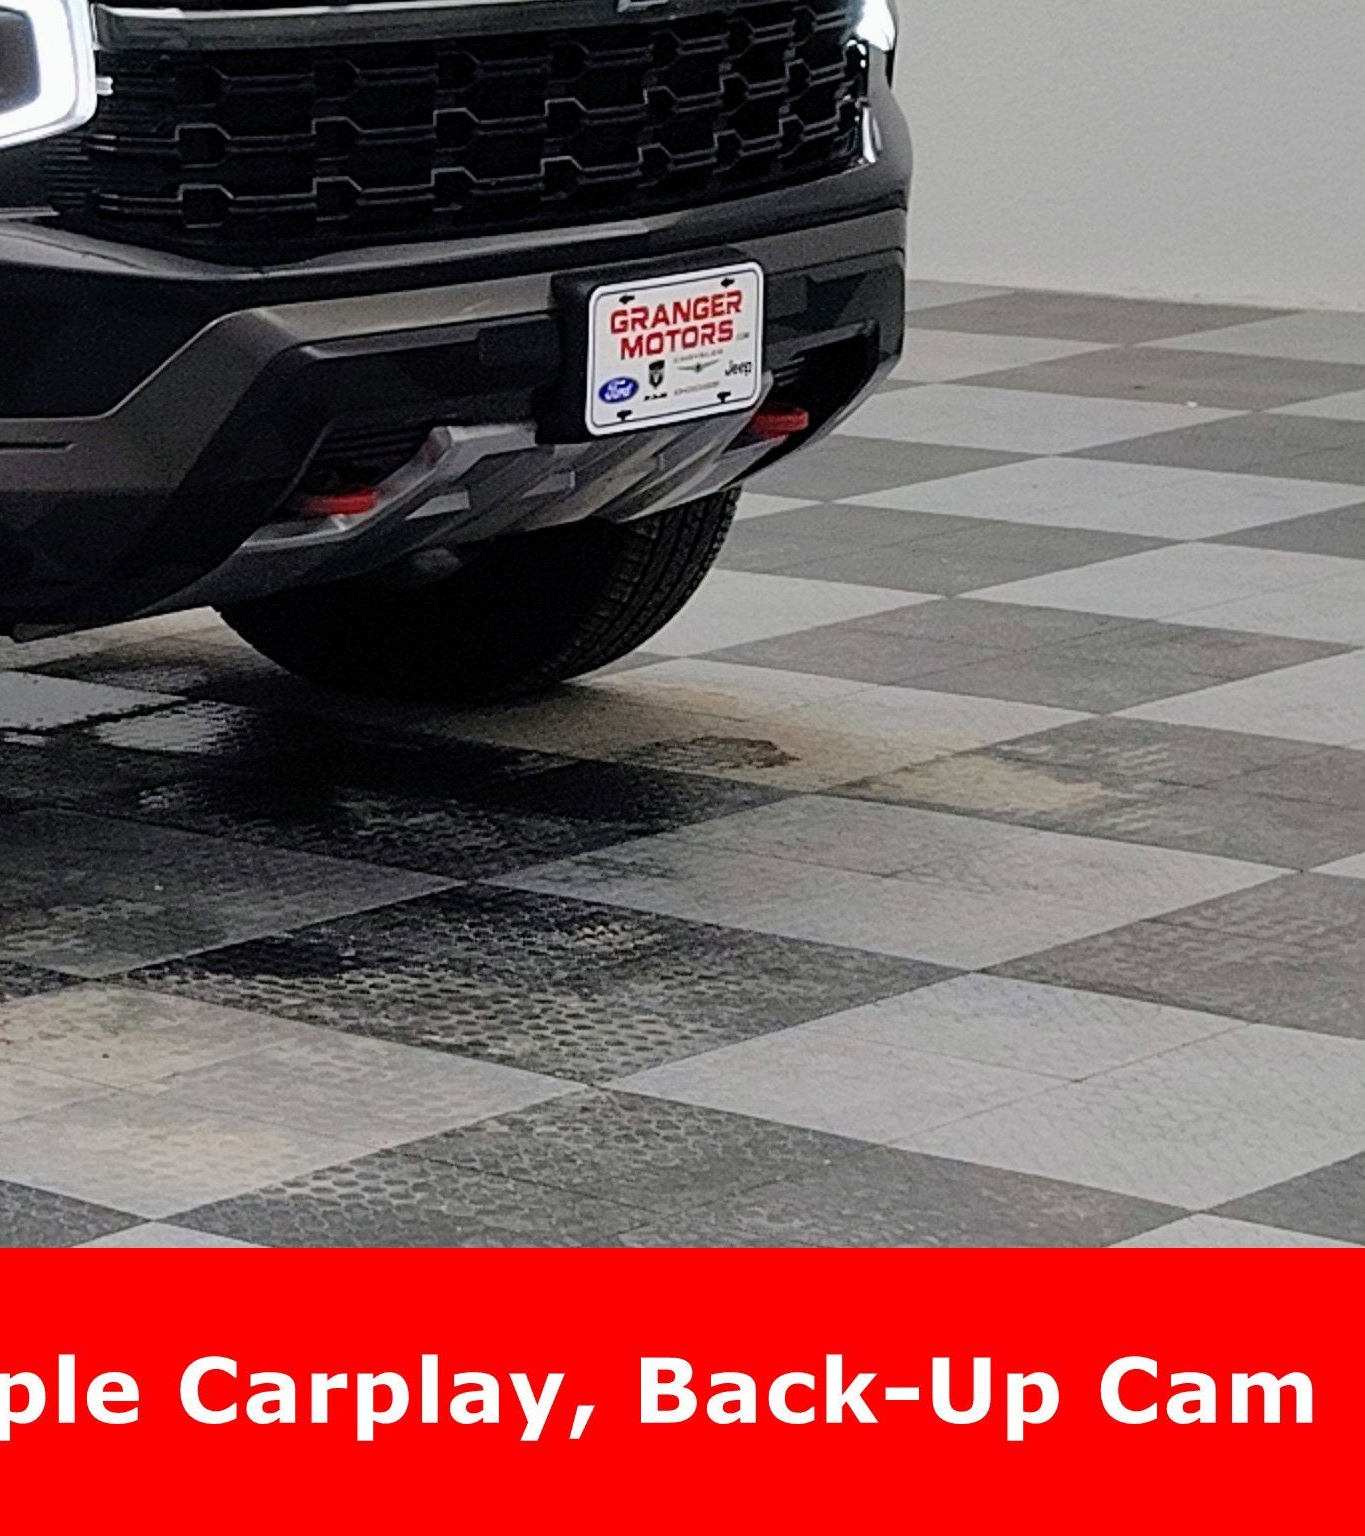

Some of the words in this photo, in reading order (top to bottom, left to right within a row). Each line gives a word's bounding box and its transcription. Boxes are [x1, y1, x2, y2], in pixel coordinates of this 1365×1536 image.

[610, 289, 744, 335] GRANGER
[620, 319, 735, 361] MOTORS
[724, 359, 753, 378] Jeep
[602, 378, 635, 402] Ford
